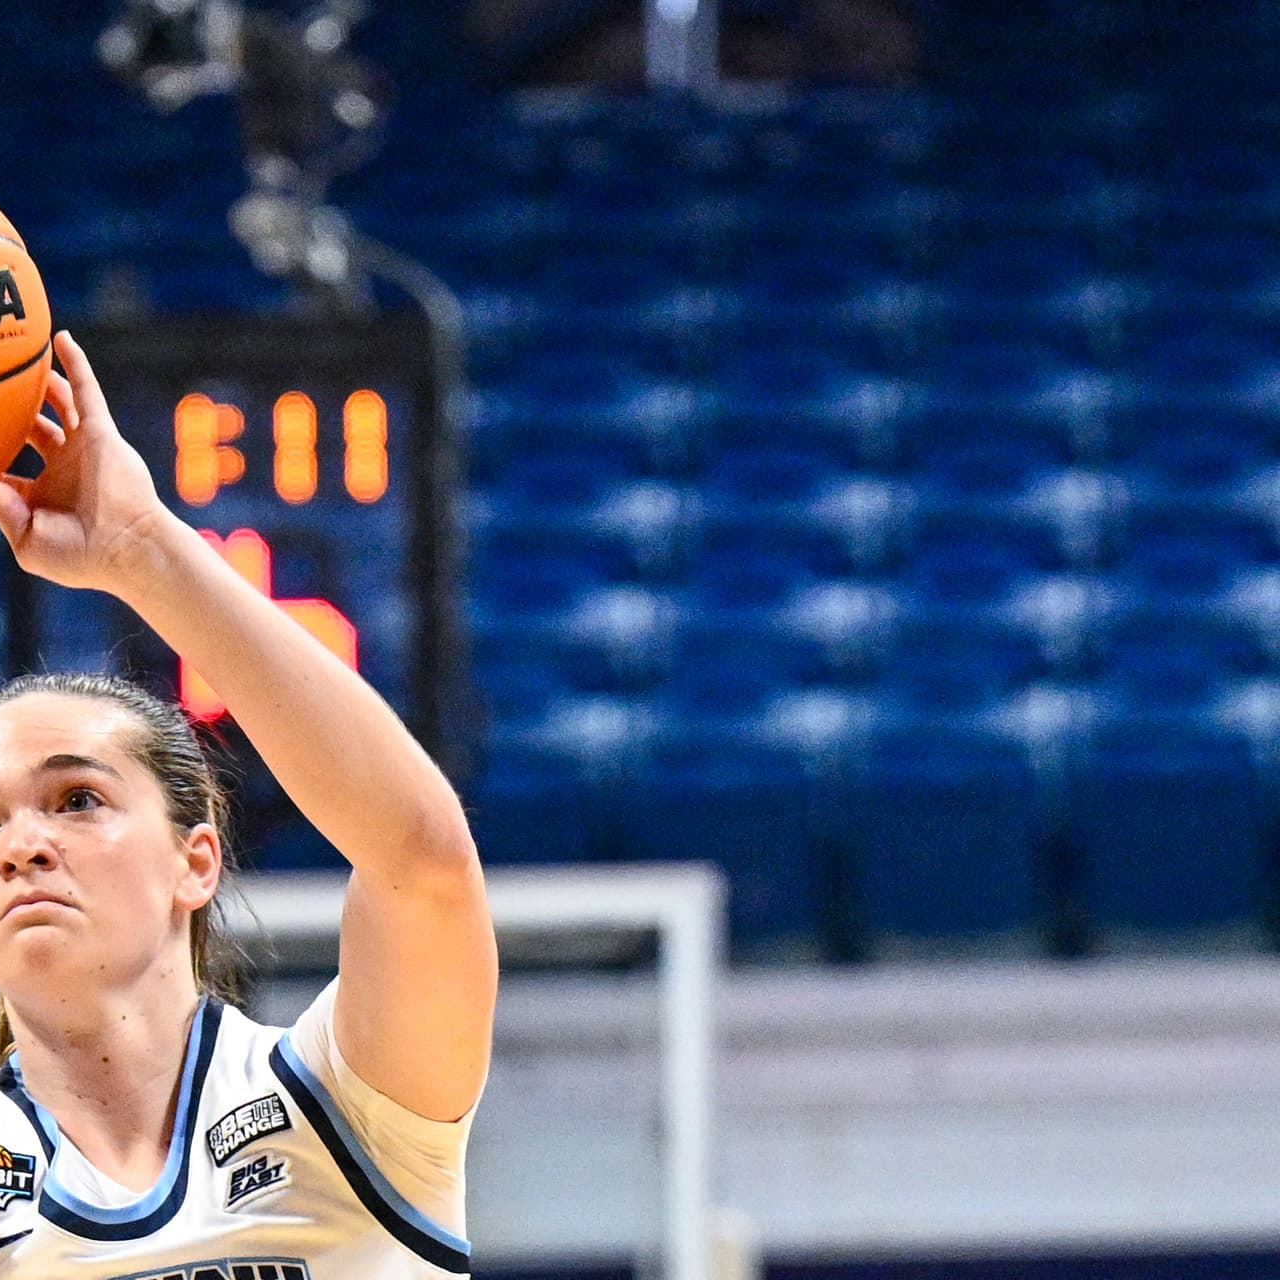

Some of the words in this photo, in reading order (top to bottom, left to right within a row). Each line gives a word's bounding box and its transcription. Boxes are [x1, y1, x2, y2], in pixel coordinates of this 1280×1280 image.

[214, 1113, 285, 1160] CHANGE
[229, 1162, 285, 1199] EAST
[231, 1155, 268, 1182] BIG
